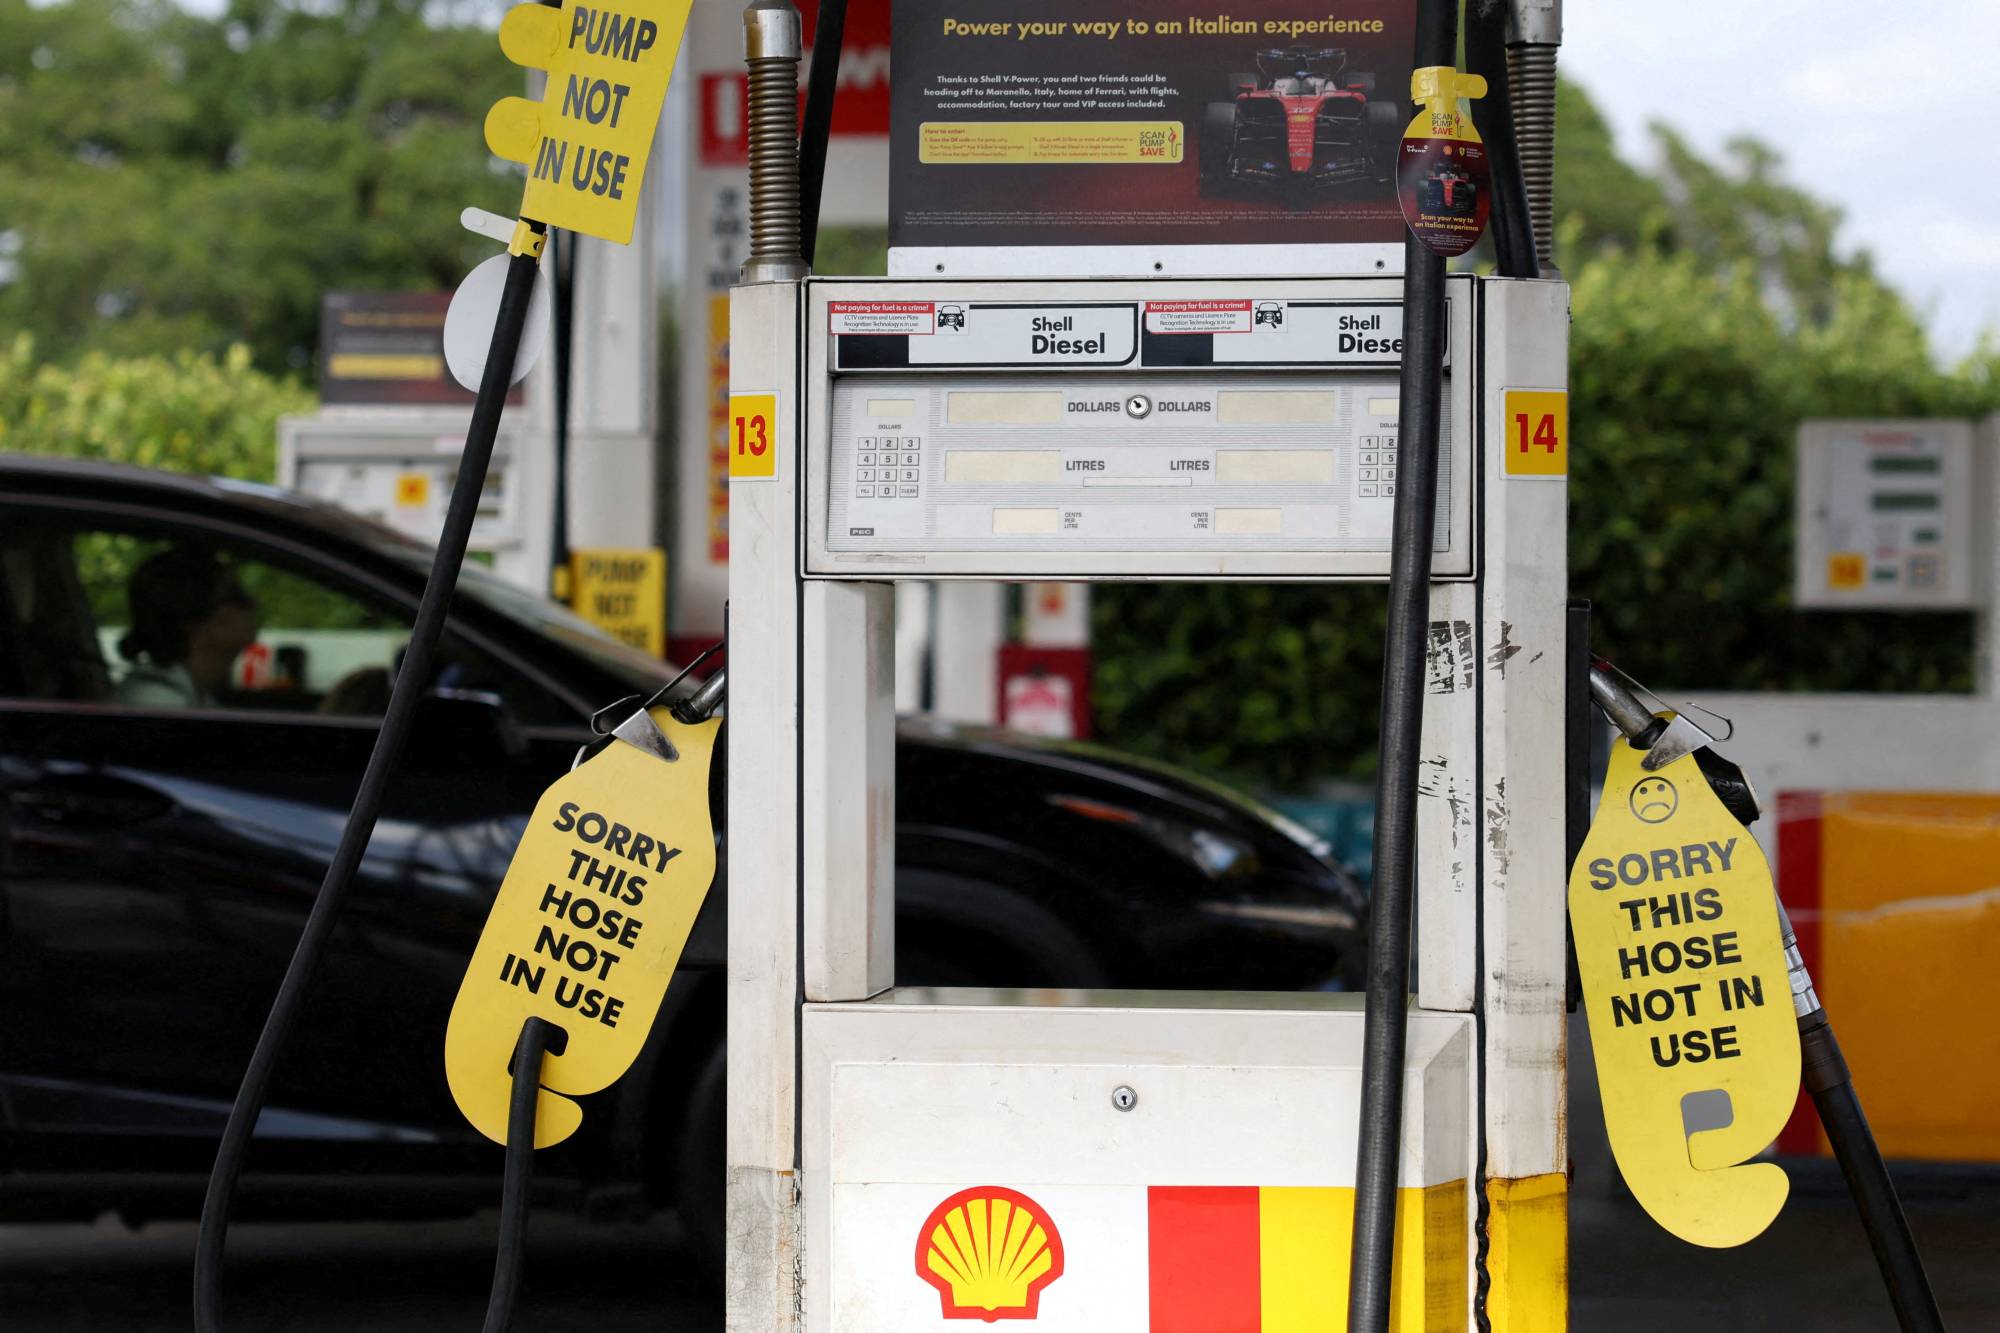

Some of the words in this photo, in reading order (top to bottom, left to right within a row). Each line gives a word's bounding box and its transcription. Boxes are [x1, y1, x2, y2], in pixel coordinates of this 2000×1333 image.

[568, 6, 657, 63] PUMP
[943, 19, 1012, 36] Power
[1017, 22, 1067, 40] your
[1072, 22, 1121, 40] way
[1127, 19, 1149, 35] to
[1155, 20, 1182, 34] an
[1189, 15, 1257, 34] Italian
[1264, 14, 1384, 38] experience
[937, 75, 967, 84] Thanks
[969, 76, 978, 84] to
[980, 75, 1001, 84] Shell
[1003, 75, 1040, 85] V-Power,
[1043, 77, 1059, 86] you
[1061, 75, 1078, 84] and
[1099, 74, 1128, 83] friends
[1130, 74, 1154, 83] could
[1156, 74, 1166, 83] be
[562, 74, 631, 128] NOT
[924, 88, 959, 97] heading
[961, 88, 973, 96] off
[986, 88, 1032, 97] Maranello,
[1034, 88, 1056, 97] Italy,
[1058, 88, 1083, 96] home
[1085, 88, 1094, 96] of
[1095, 88, 1126, 97] Ferrari,
[1129, 87, 1148, 95] with
[1150, 87, 1179, 97] flights,
[937, 101, 1008, 110] accommodation,
[1010, 100, 1041, 110] factory
[1043, 101, 1061, 109] tour
[1063, 100, 1080, 109] and
[1127, 100, 1166, 109] included.
[1140, 131, 1165, 139] SCAN
[1140, 139, 1165, 147] PUMP
[533, 136, 568, 185] IN
[572, 145, 630, 201] USE
[848, 305, 871, 313] paying
[1164, 303, 1187, 311] paying
[1032, 316, 1072, 331] Shell
[1339, 315, 1380, 330] Shell
[1032, 332, 1105, 354] Diesel
[1339, 332, 1402, 353] Diese
[1068, 402, 1120, 412] DOLLARS
[1158, 402, 1211, 412] DOLLARS
[735, 415, 767, 456] 13
[1516, 413, 1558, 454] 14
[907, 440, 913, 448] 3
[1066, 461, 1105, 471] LITRES
[1170, 460, 1210, 471] LITRES
[885, 471, 890, 479] 8
[906, 471, 912, 479] 9
[884, 487, 890, 495] 0
[1387, 487, 1394, 495] 0
[552, 801, 682, 875] SORRY
[1588, 837, 1738, 891] SORRY
[567, 848, 649, 906] THIS
[538, 883, 643, 950] HOSE
[1620, 888, 1724, 931] THIS
[533, 925, 620, 982] NOT
[1618, 932, 1743, 980] HOSE
[499, 953, 546, 995] IN
[554, 976, 625, 1029] USE
[1610, 984, 1702, 1028] NOT
[1719, 974, 1765, 1012] IN
[1650, 1026, 1742, 1069] USE
